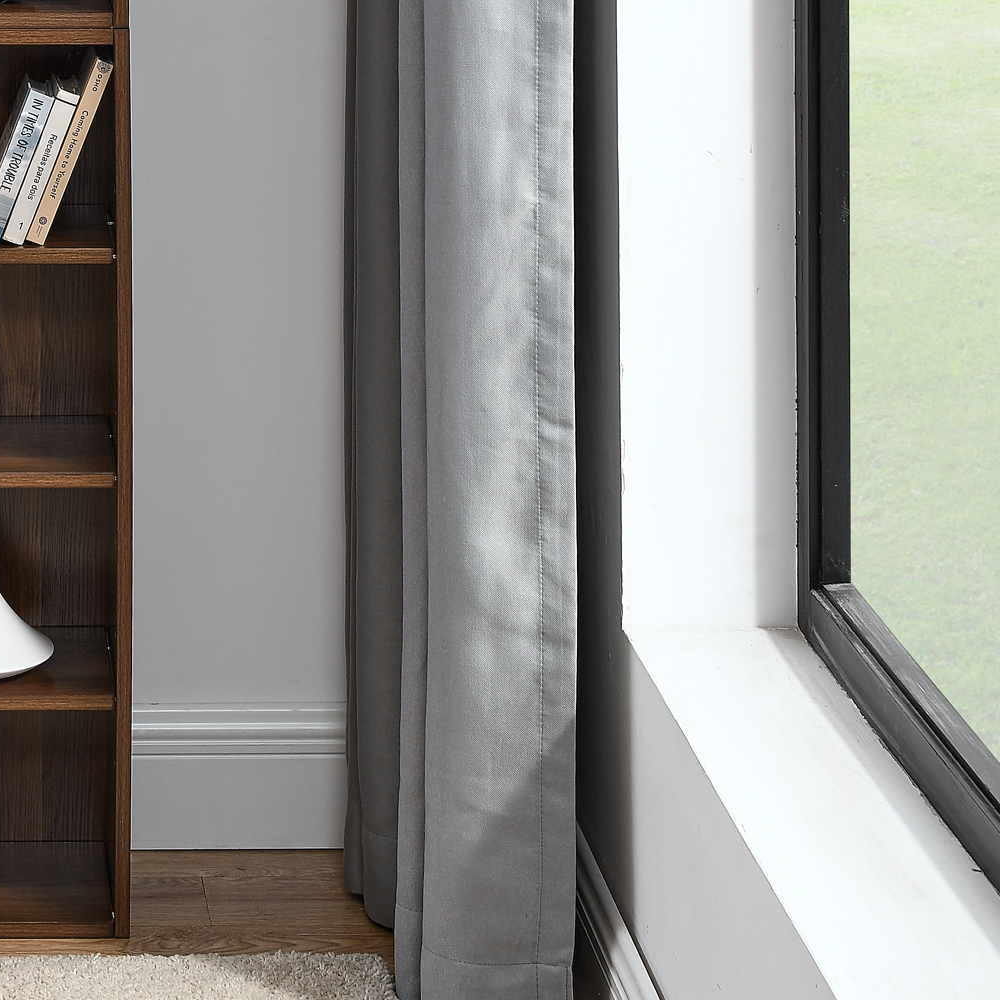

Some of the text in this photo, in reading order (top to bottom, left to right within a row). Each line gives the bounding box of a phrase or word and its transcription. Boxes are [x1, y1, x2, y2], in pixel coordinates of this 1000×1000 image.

[92, 74, 102, 92] OSHO
[0, 98, 45, 193] IN TIMES OF TROUBLE
[27, 133, 58, 201] Receitas para dois
[49, 110, 89, 200] Coming Home to Yourself
